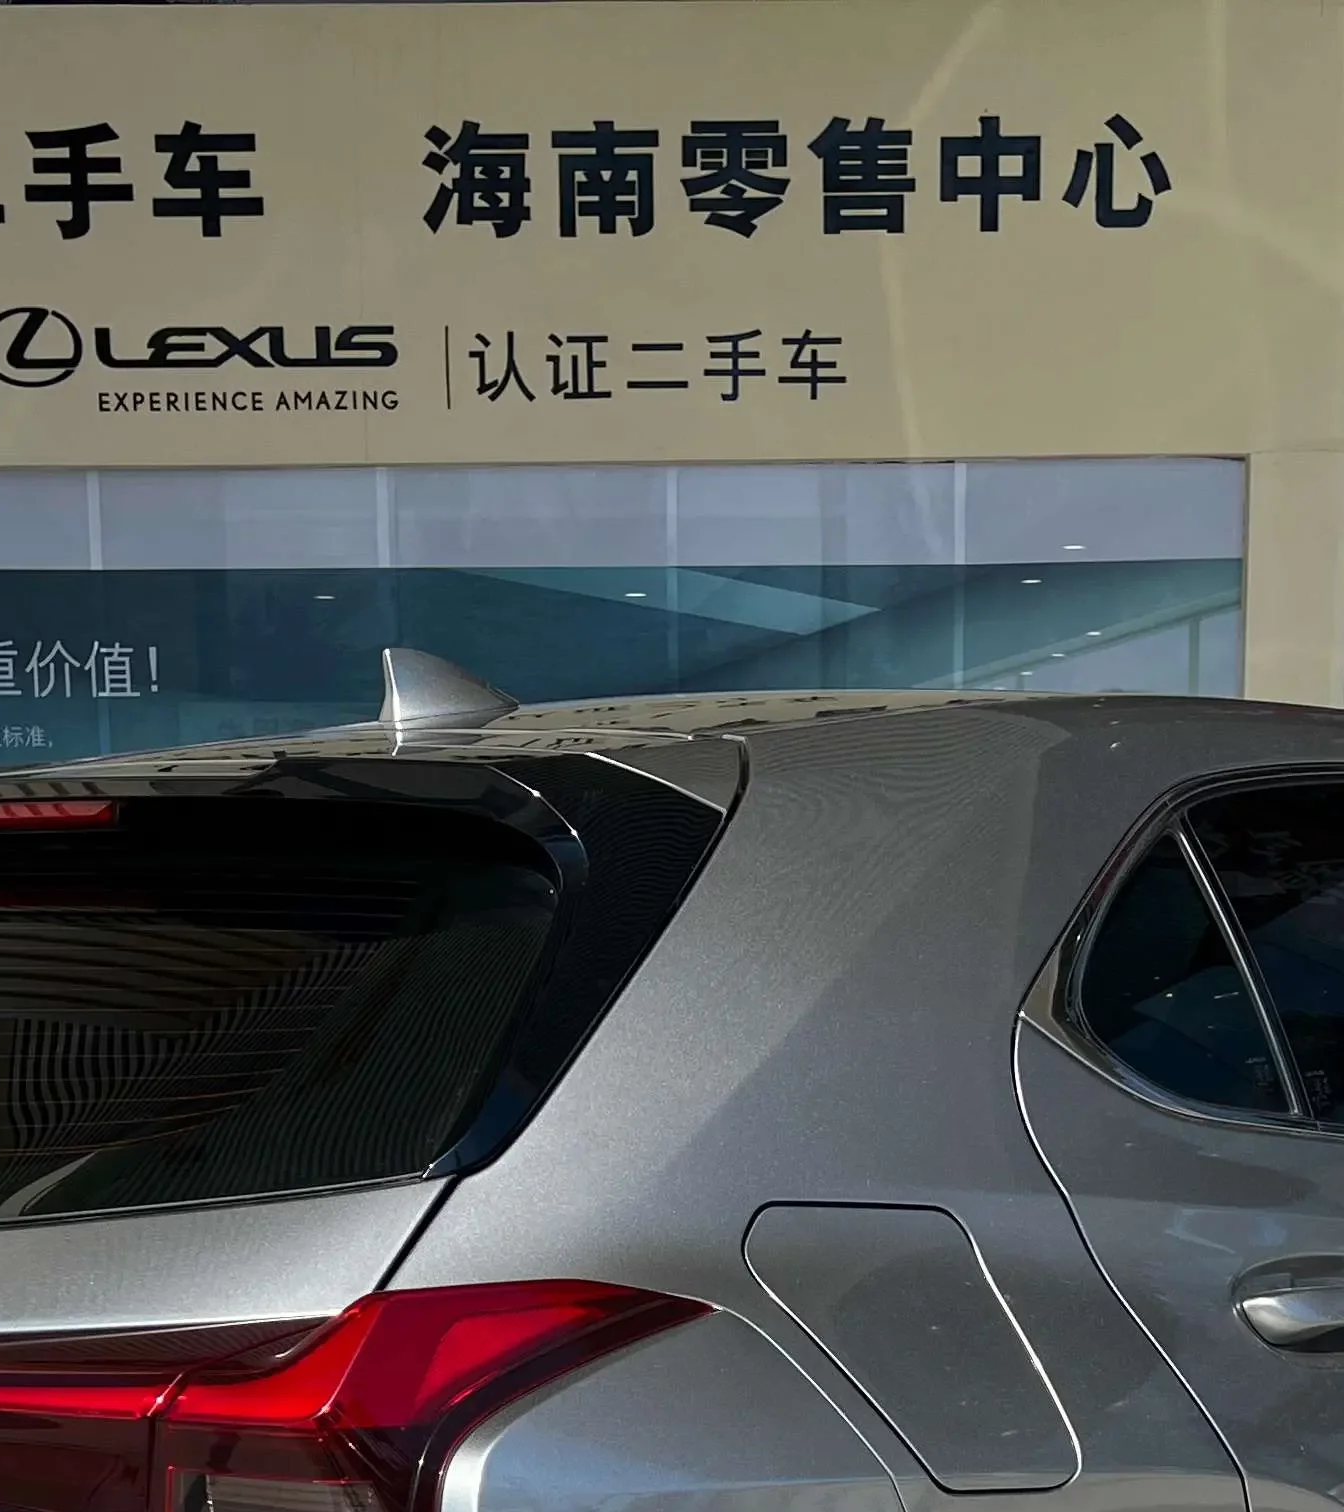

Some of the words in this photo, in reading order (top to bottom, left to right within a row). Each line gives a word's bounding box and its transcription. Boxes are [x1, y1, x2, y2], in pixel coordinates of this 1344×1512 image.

[422, 113, 1172, 240] 海南零售中心
[94, 326, 399, 368] LEXUS
[468, 328, 847, 402] 认证二手车
[98, 391, 264, 412] EXPERIENCE
[275, 390, 400, 411] AMAZING
